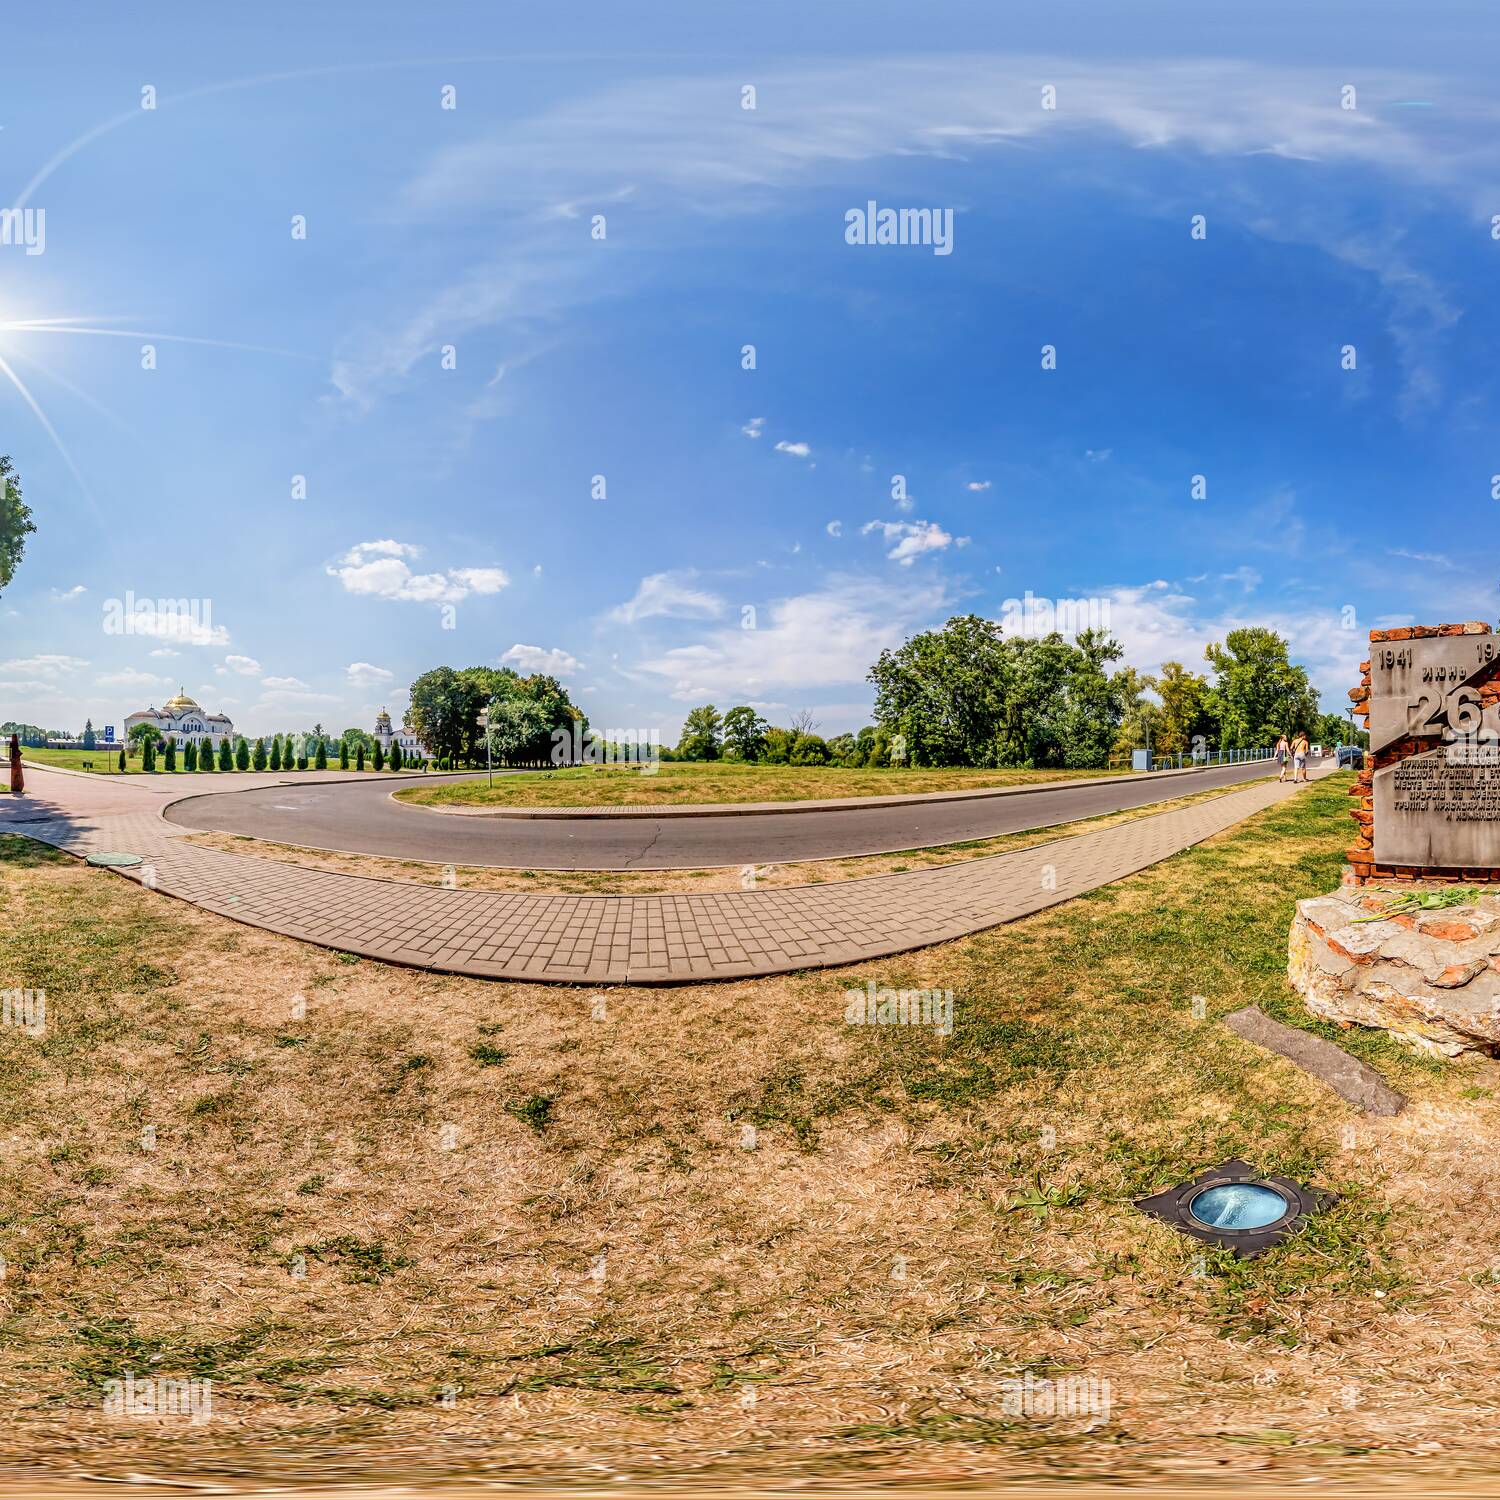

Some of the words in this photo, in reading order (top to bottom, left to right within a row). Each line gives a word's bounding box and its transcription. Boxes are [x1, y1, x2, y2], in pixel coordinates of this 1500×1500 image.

[1379, 648, 1412, 670] 1941
[1423, 665, 1466, 682] ИЮНЬ
[1407, 686, 1483, 736] 26
[1394, 769, 1434, 780] СВОДНОЙ
[1439, 769, 1473, 780] ГРУППЫ
[1479, 769, 1486, 779] В
[1394, 780, 1422, 790] МЕСТЕ
[1426, 781, 1446, 790] БЫЛ
[1409, 791, 1446, 801] ПРОРЫВ
[1452, 791, 1463, 800] ИЗ
[1394, 801, 1428, 811] ГРУППЫ
